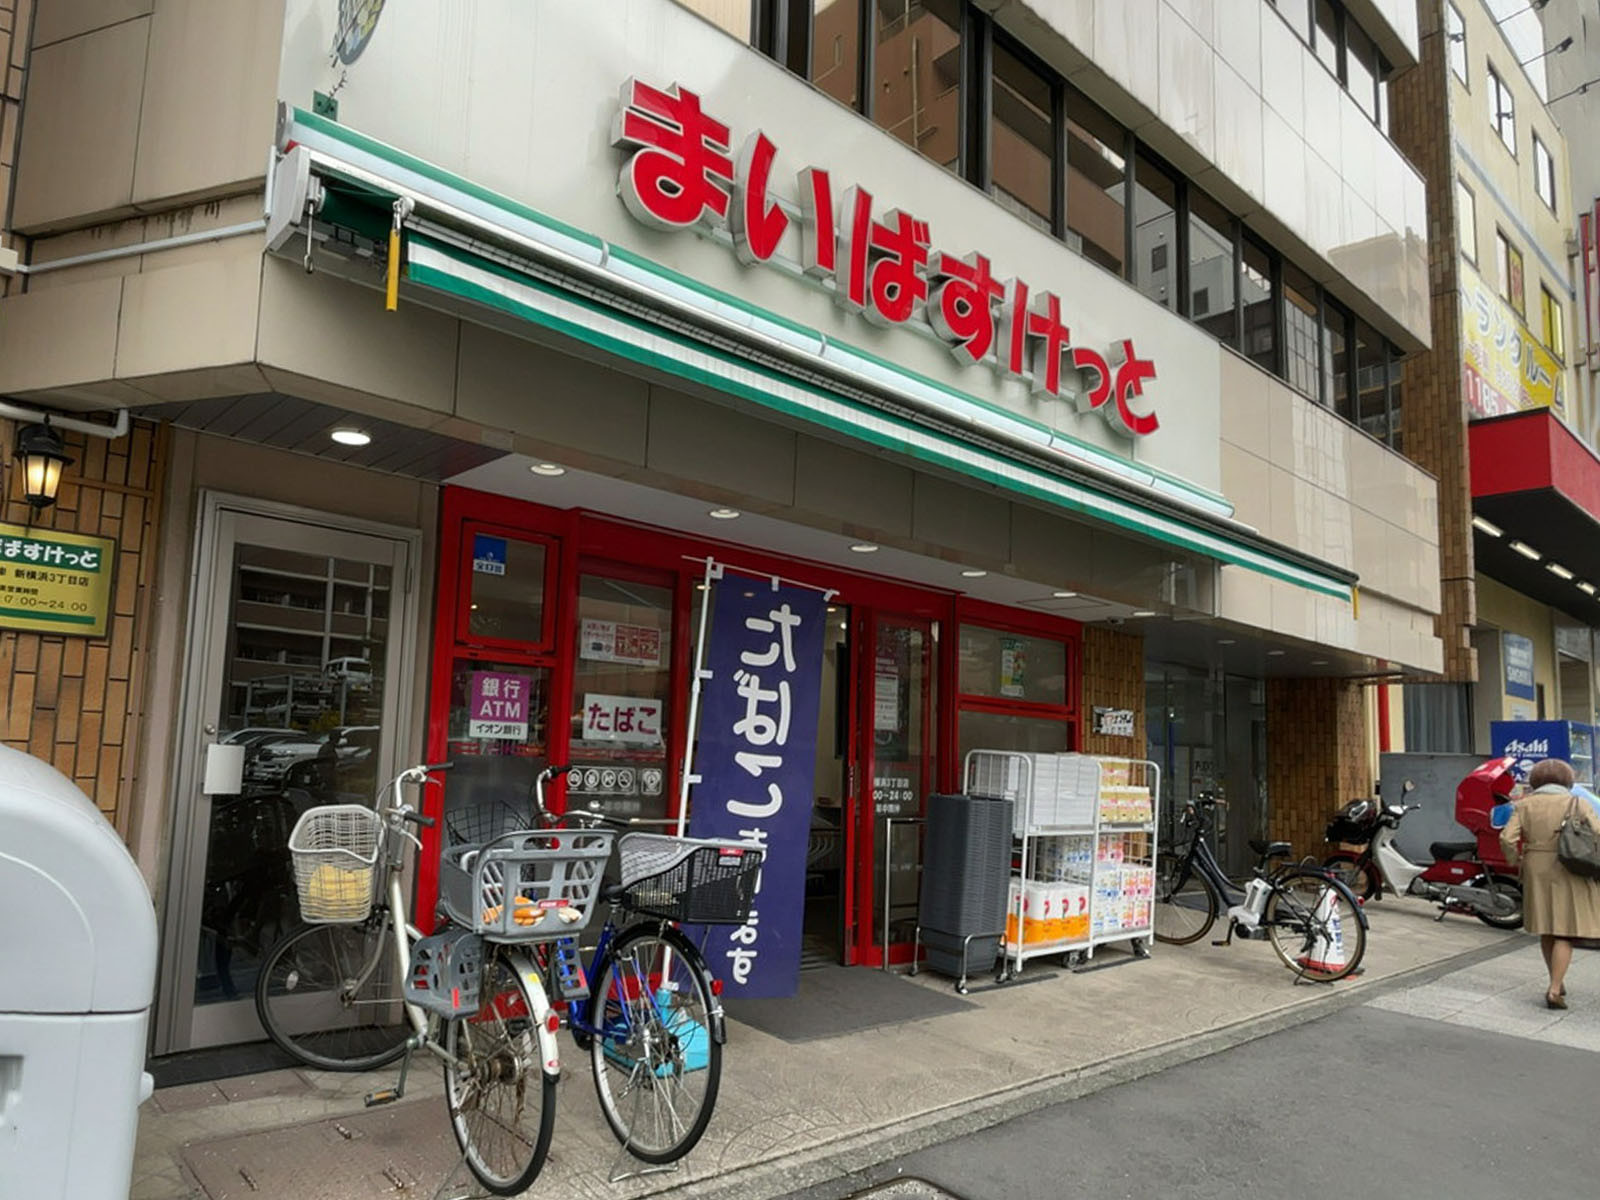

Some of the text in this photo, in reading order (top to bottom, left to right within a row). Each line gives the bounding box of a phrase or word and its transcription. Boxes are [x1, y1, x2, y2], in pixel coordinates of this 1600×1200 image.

[614, 77, 1161, 437] まいばすけっと
[481, 677, 521, 699] 銀行
[479, 700, 521, 719] ATM
[588, 703, 657, 735] たばこ
[476, 723, 522, 736] イオン銀行
[1505, 739, 1548, 753] Asahi
